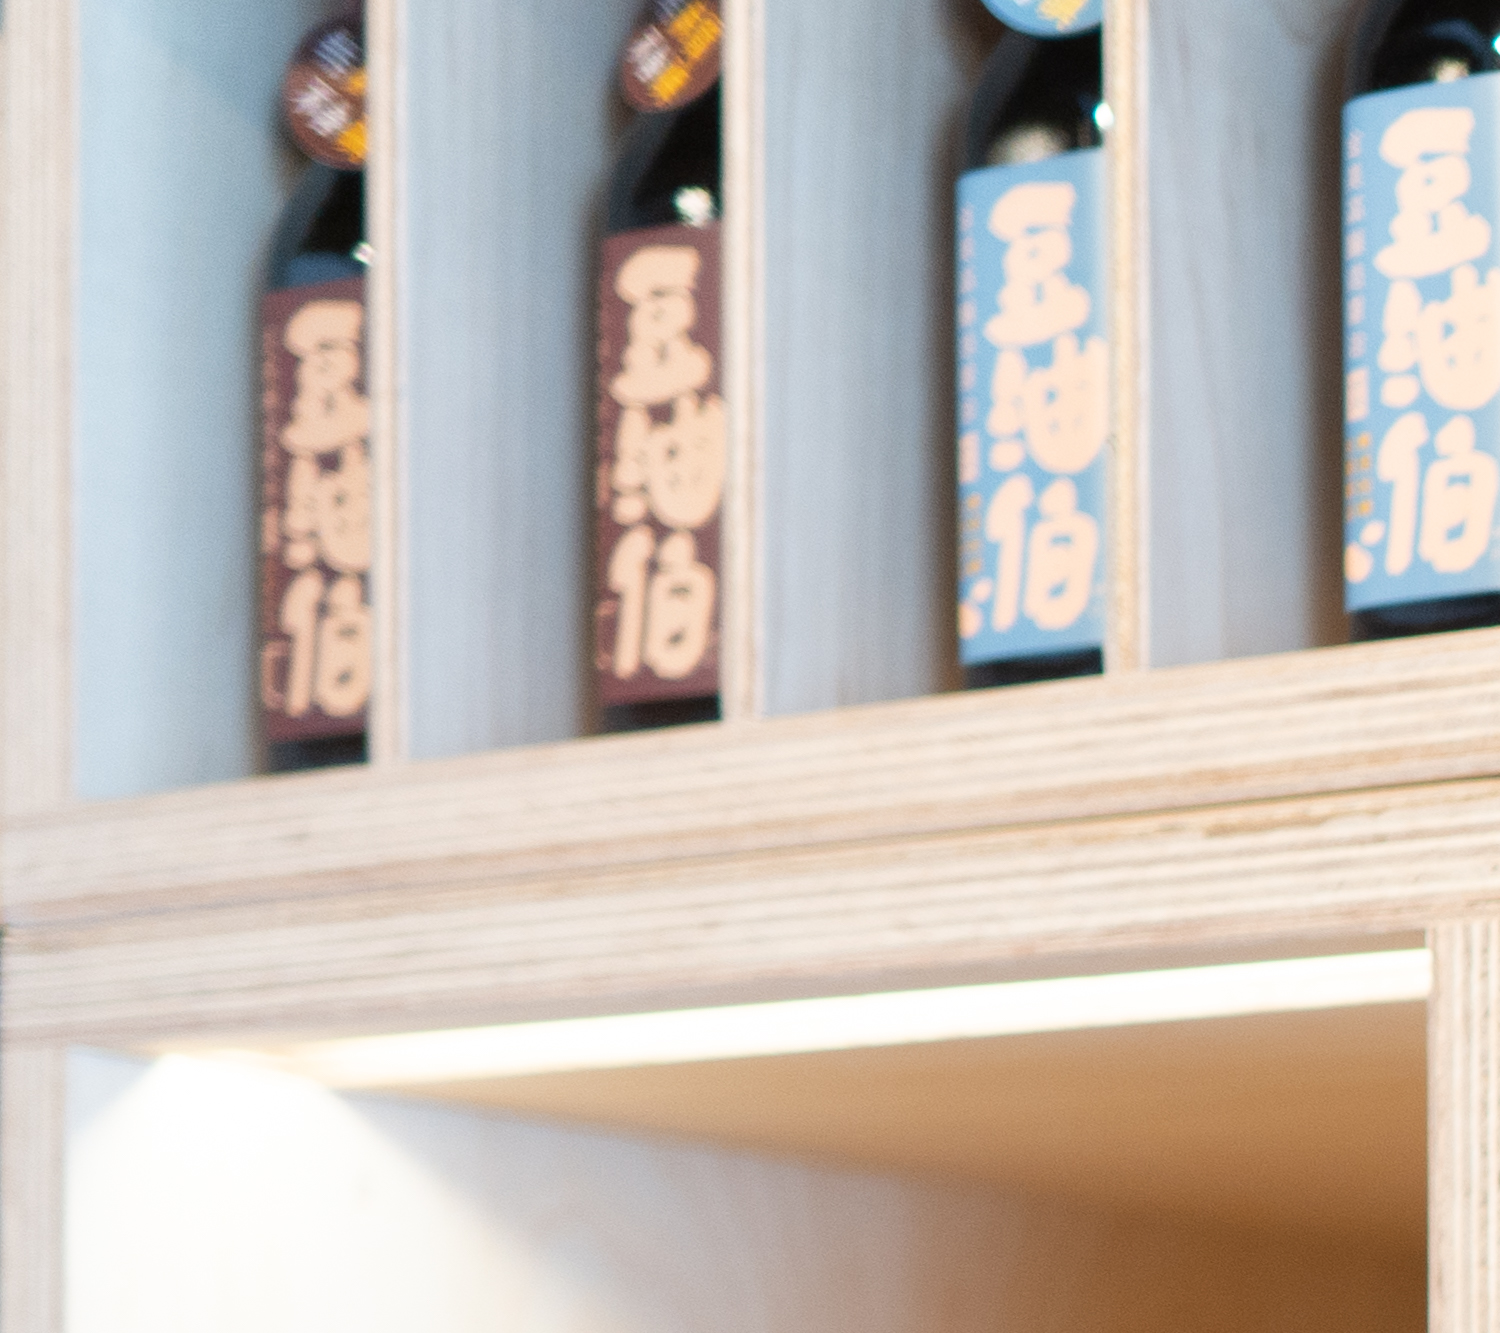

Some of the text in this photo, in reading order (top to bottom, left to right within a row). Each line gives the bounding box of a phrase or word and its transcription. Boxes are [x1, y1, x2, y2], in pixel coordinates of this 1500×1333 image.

[282, 300, 369, 716] 豆油伯
[610, 245, 727, 679] 豆油伯
[985, 182, 1106, 629] 豆油伯
